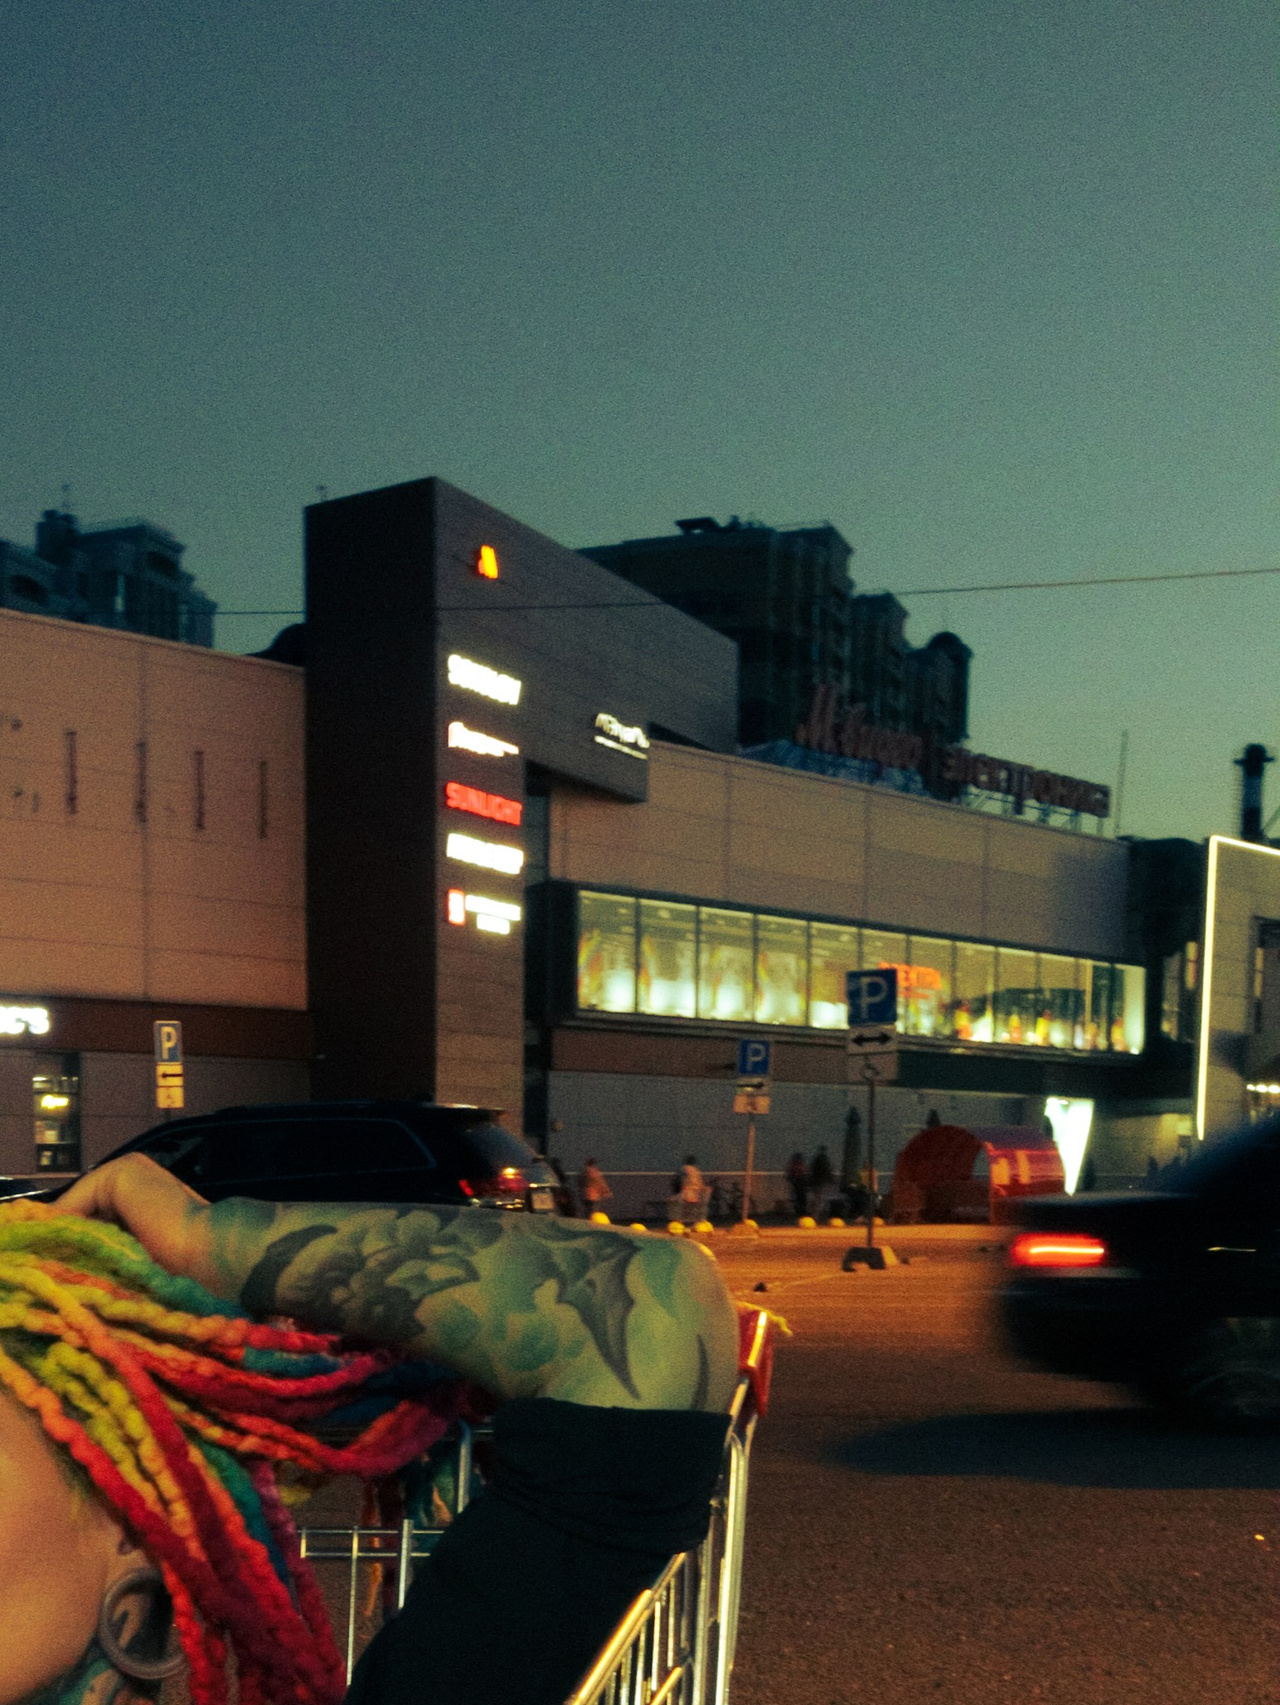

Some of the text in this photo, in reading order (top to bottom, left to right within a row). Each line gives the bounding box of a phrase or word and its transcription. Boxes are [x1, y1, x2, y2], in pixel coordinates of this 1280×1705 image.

[859, 975, 890, 1019] P
[160, 1026, 177, 1059] P
[747, 1043, 767, 1072] P
